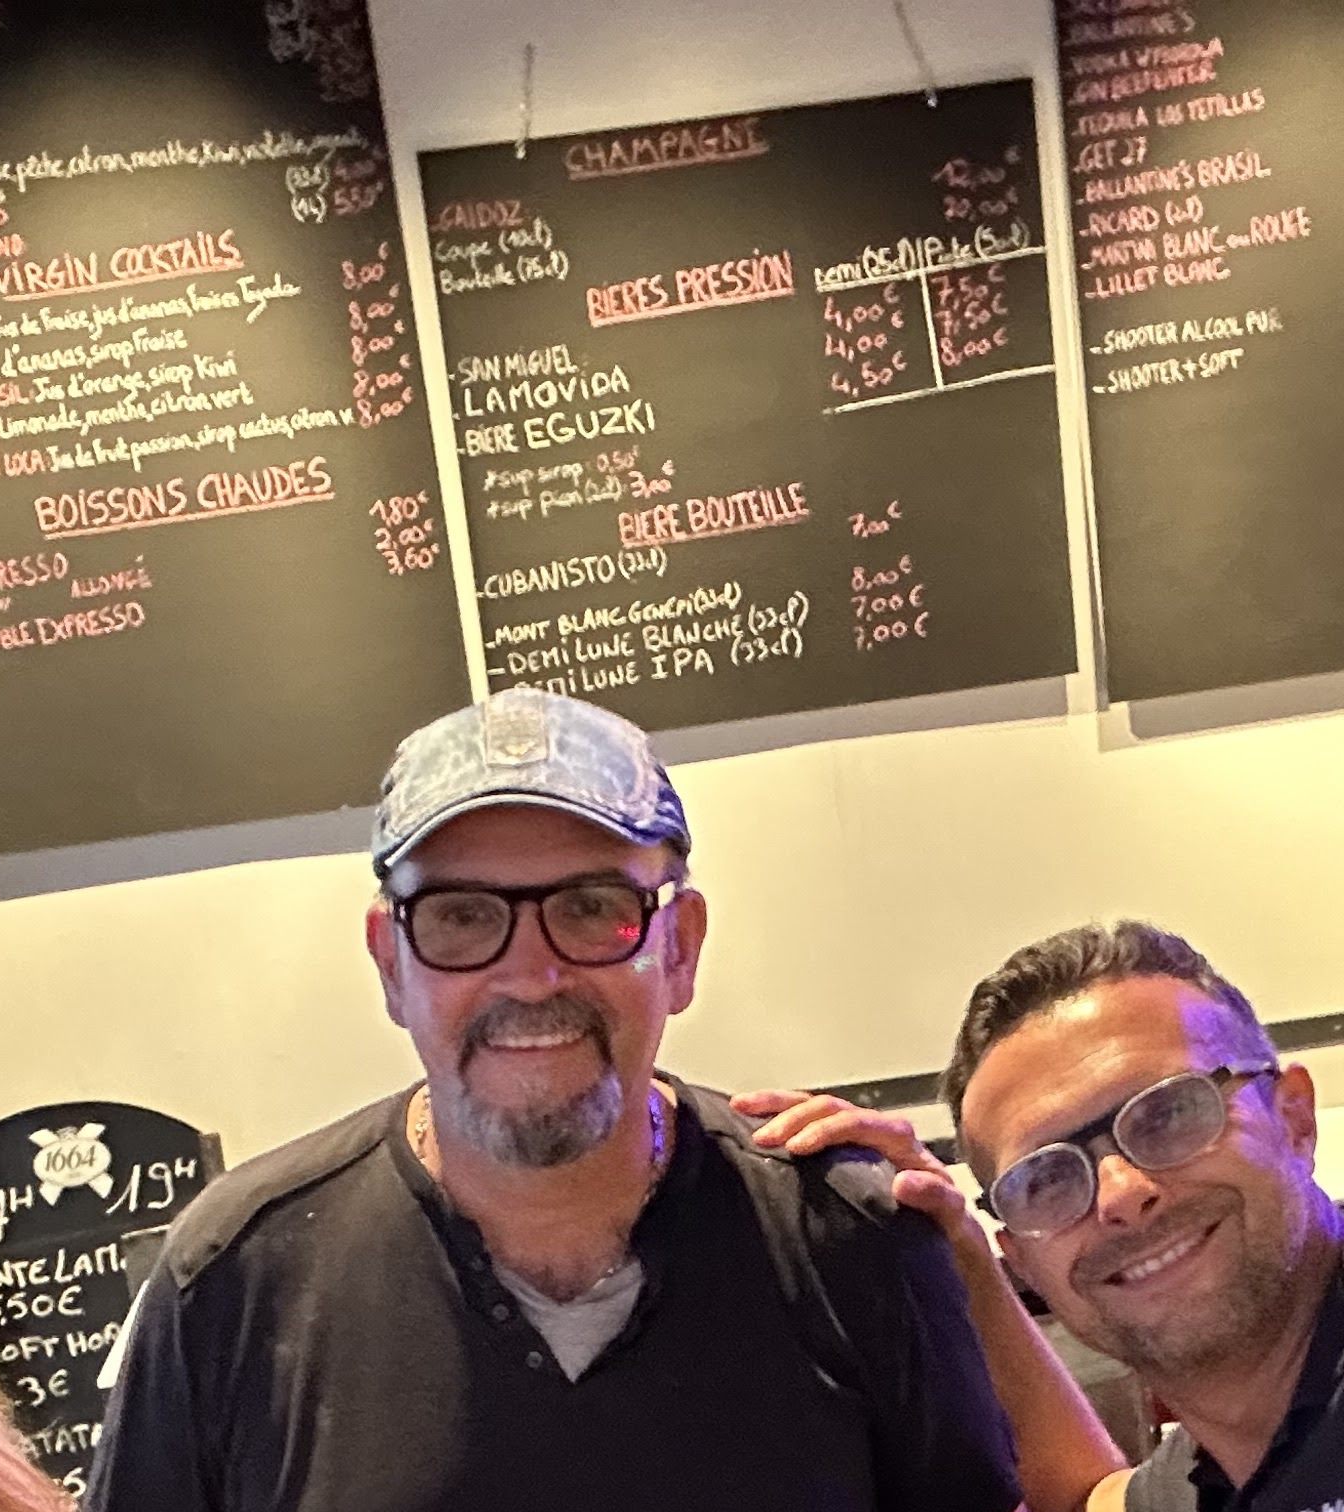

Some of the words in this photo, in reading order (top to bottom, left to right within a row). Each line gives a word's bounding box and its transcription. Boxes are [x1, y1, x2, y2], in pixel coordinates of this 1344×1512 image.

[675, 247, 794, 305] PRESSION
[524, 398, 656, 449] EGUZKI
[34, 477, 187, 532] BOISSONS
[197, 456, 333, 510] CHAUDES
[686, 482, 810, 532] BOUTEILLE
[482, 554, 616, 600] CUBANISTO
[33, 602, 146, 645] EXPRESSO
[495, 620, 551, 649] MONT
[557, 607, 626, 638] BLANC
[575, 629, 636, 663] LUNE
[642, 613, 744, 653] BLANCHE
[581, 660, 641, 693] LUNE
[43, 1145, 98, 1172] 1664
